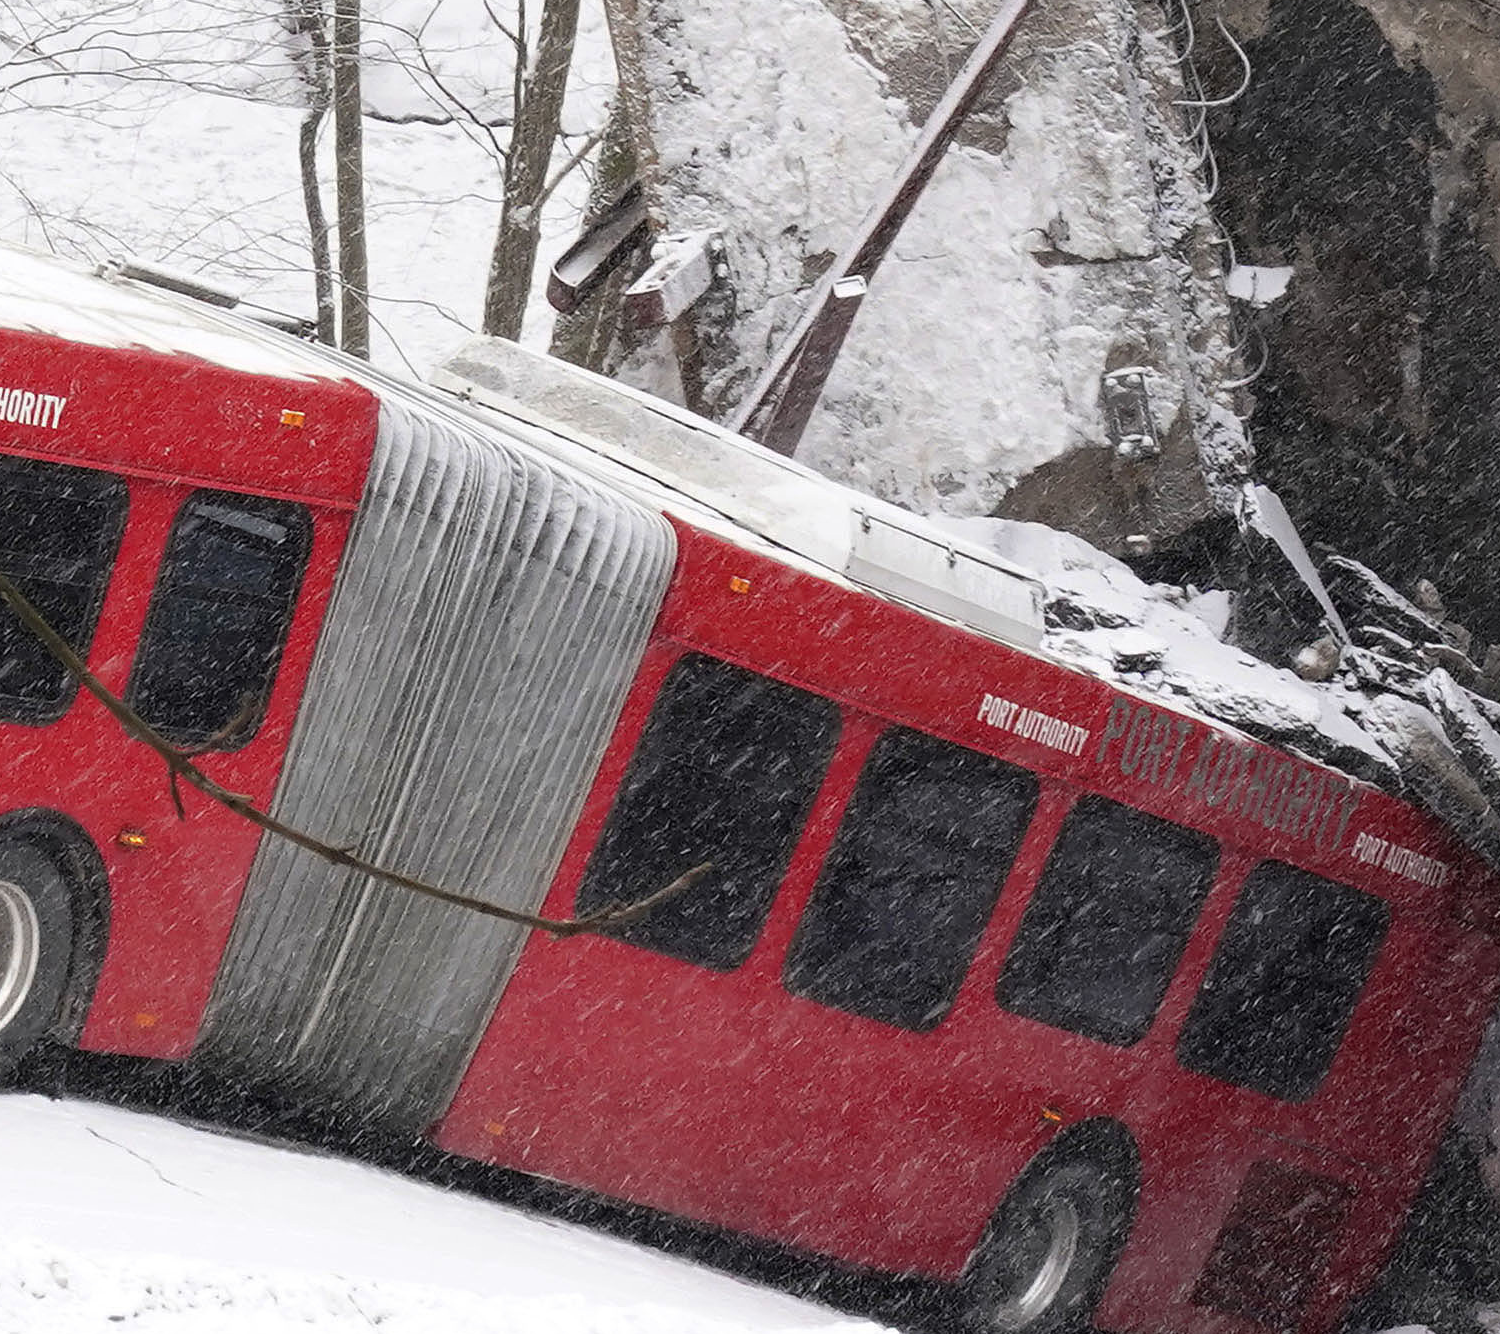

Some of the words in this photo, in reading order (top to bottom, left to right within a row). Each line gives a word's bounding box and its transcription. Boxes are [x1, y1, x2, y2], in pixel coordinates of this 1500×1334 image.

[977, 692, 1019, 732] PORT
[1012, 707, 1091, 757] AUTHORITY
[1095, 697, 1194, 790] PORT
[1183, 730, 1365, 852] AUTHORITY
[1350, 831, 1389, 867] PORT
[1382, 842, 1449, 889] AUTHORITY
